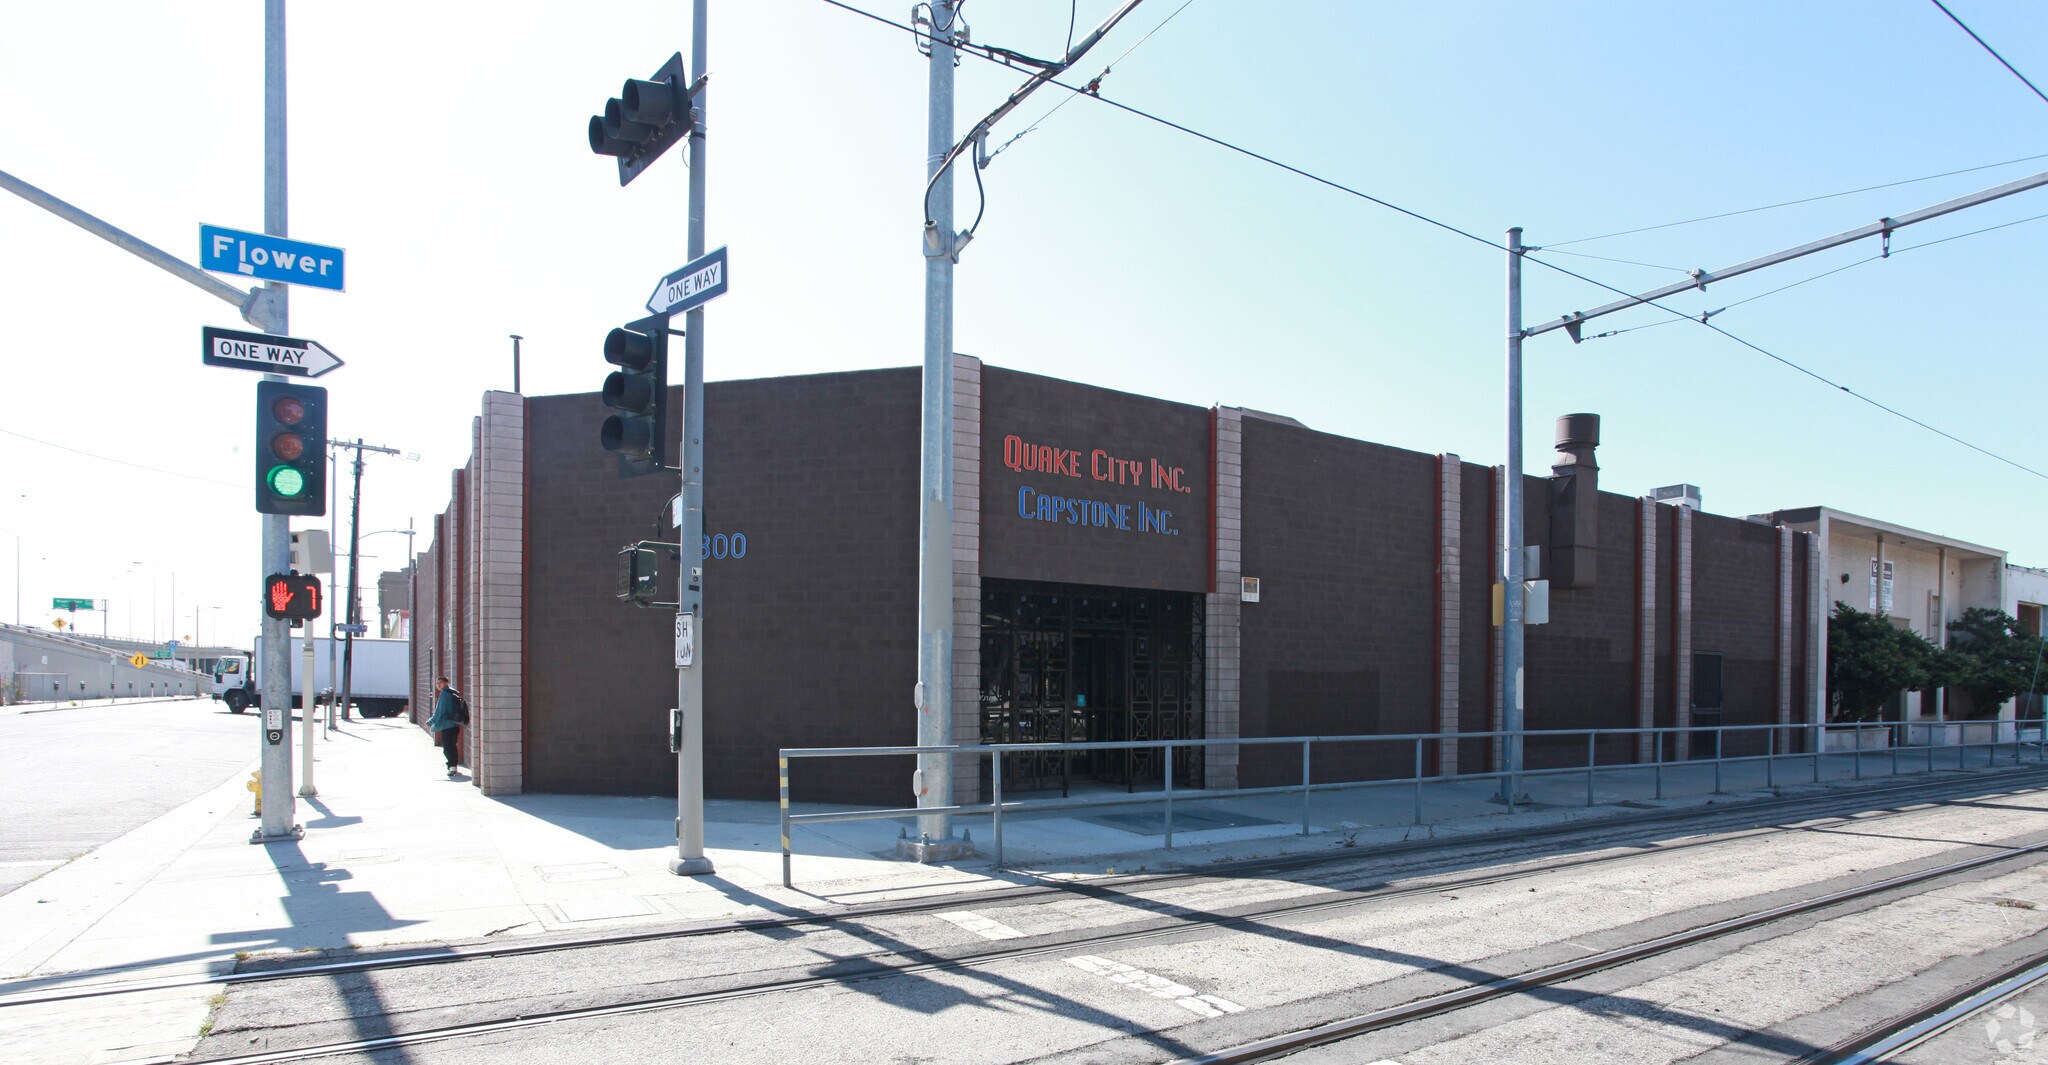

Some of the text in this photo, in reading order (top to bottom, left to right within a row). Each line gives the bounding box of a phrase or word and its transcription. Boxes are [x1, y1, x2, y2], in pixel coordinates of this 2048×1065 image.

[213, 234, 333, 277] Flower
[668, 265, 718, 303] ONE WAY
[220, 341, 305, 365] ONE WAY
